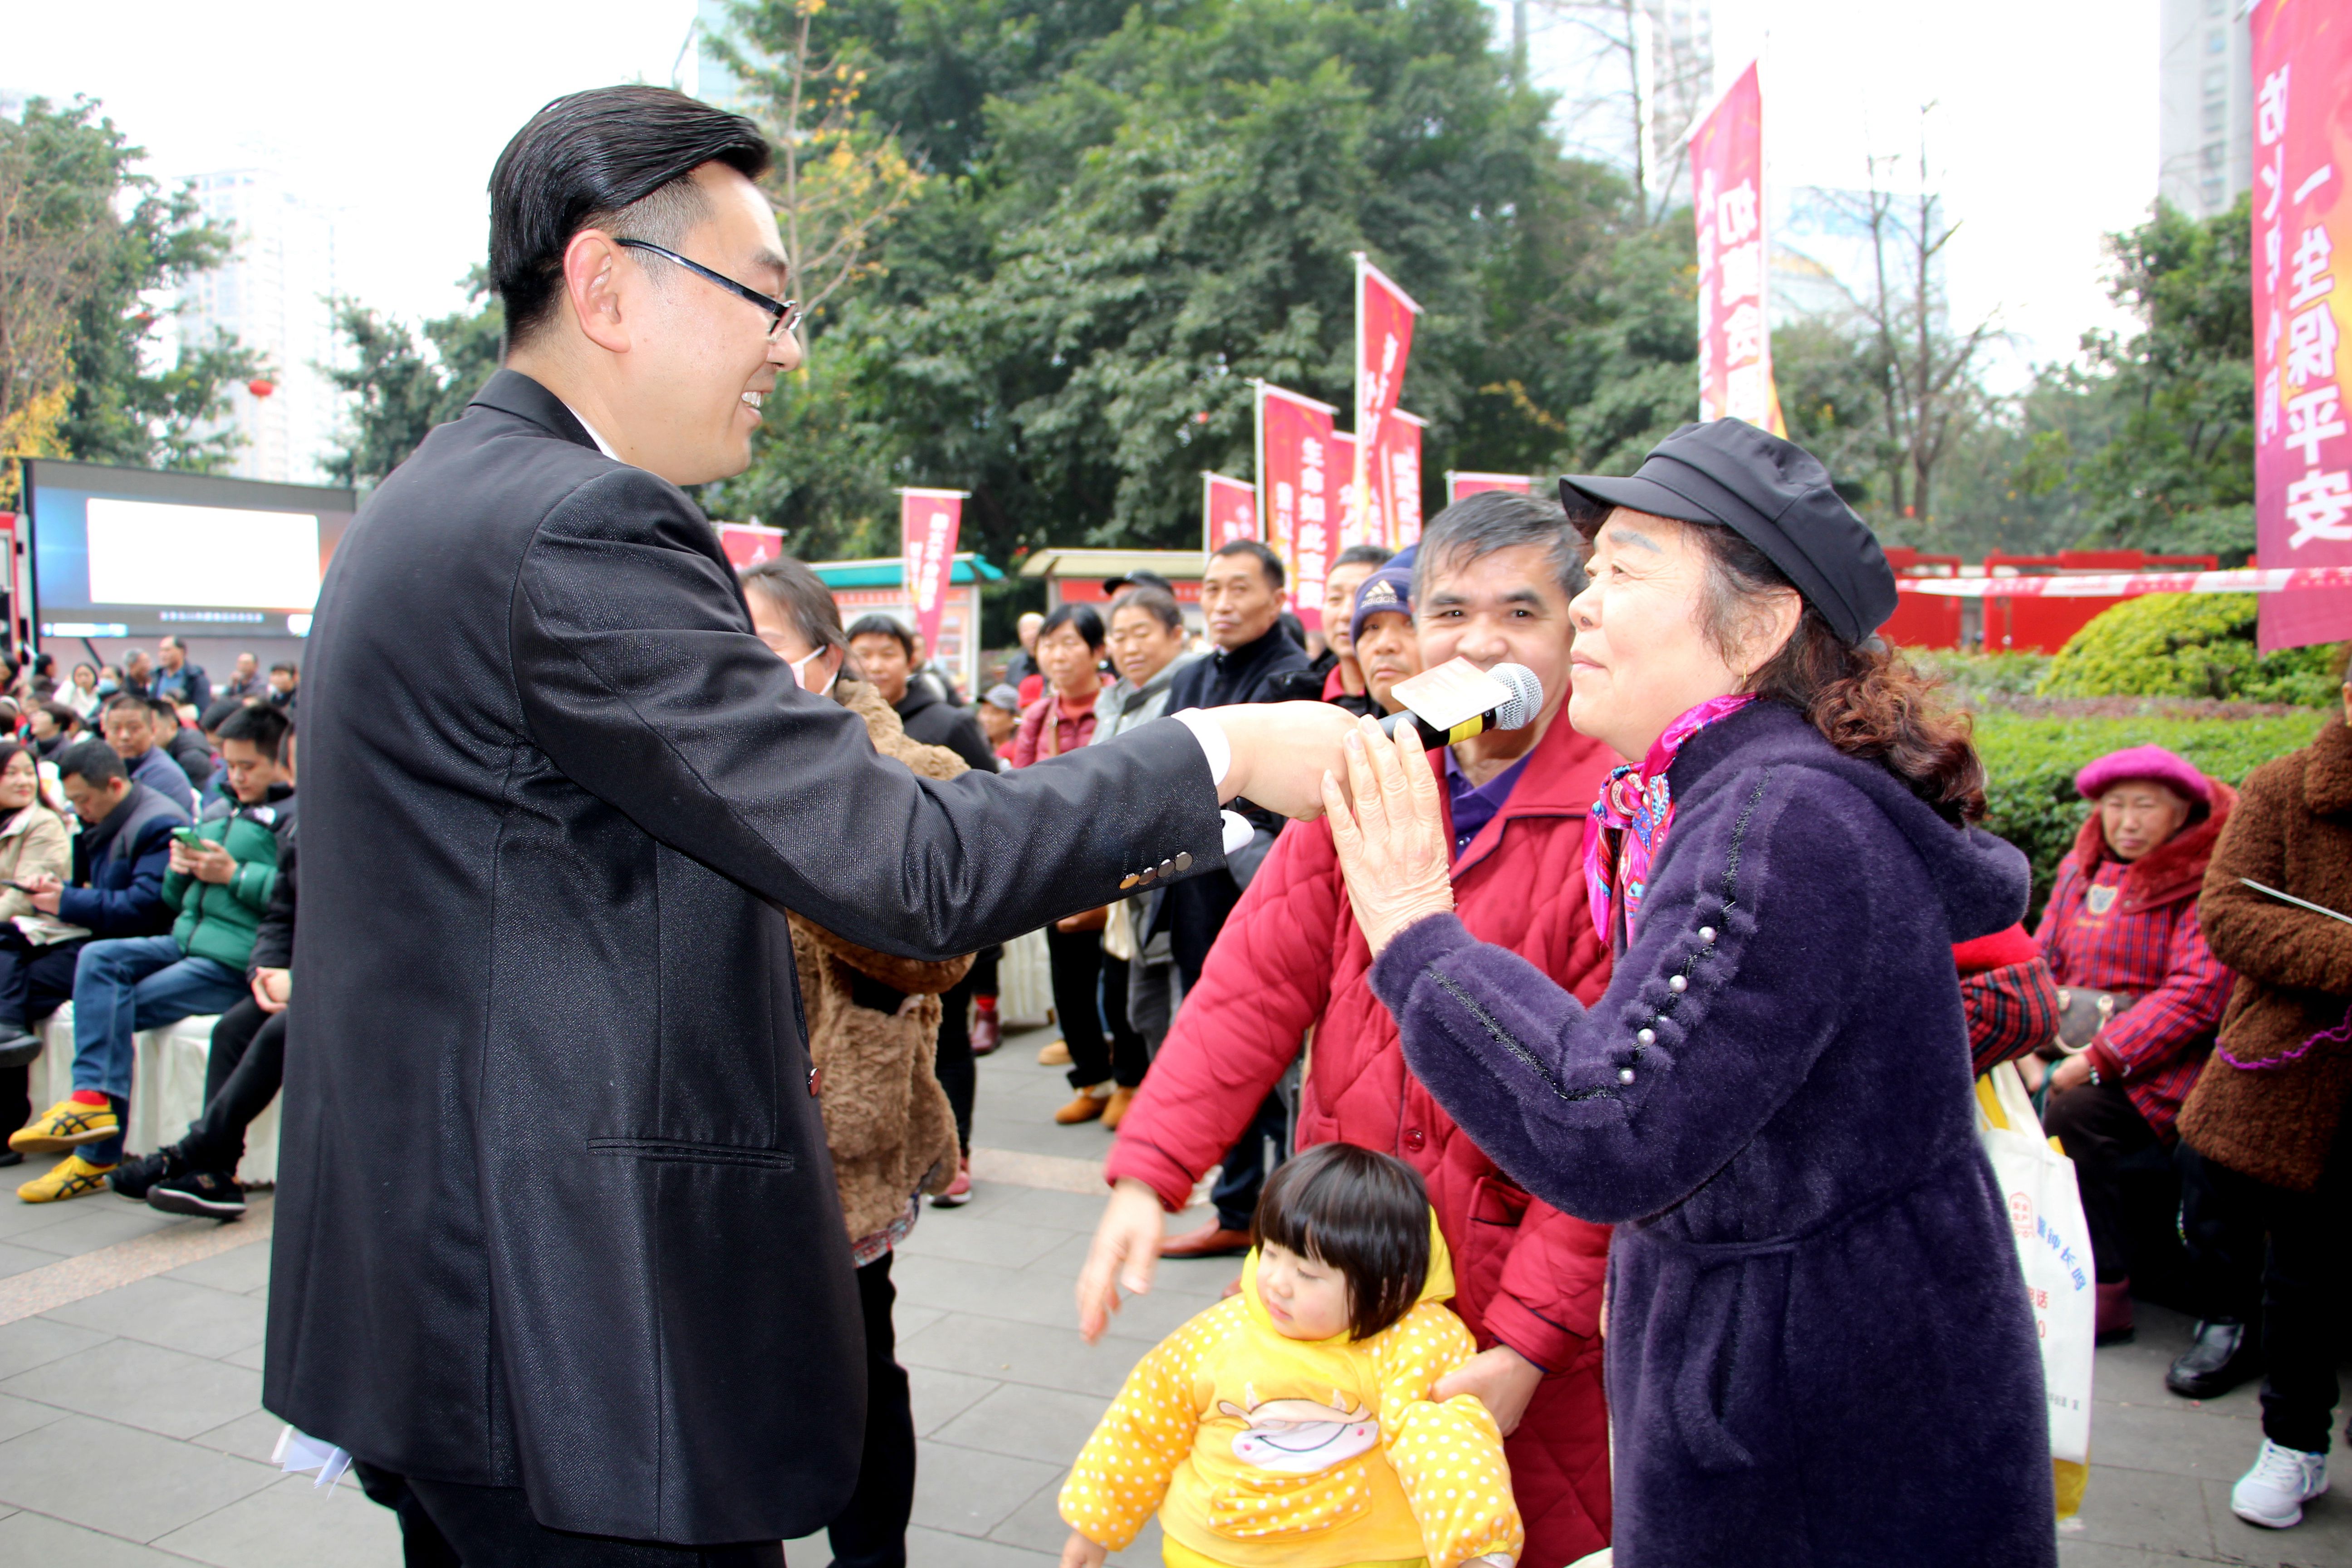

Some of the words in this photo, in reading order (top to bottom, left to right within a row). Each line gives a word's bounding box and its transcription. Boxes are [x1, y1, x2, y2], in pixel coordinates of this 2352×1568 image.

[1361, 594, 1397, 608] adidas
[2038, 1214, 2087, 1291] 警钟长鸣
